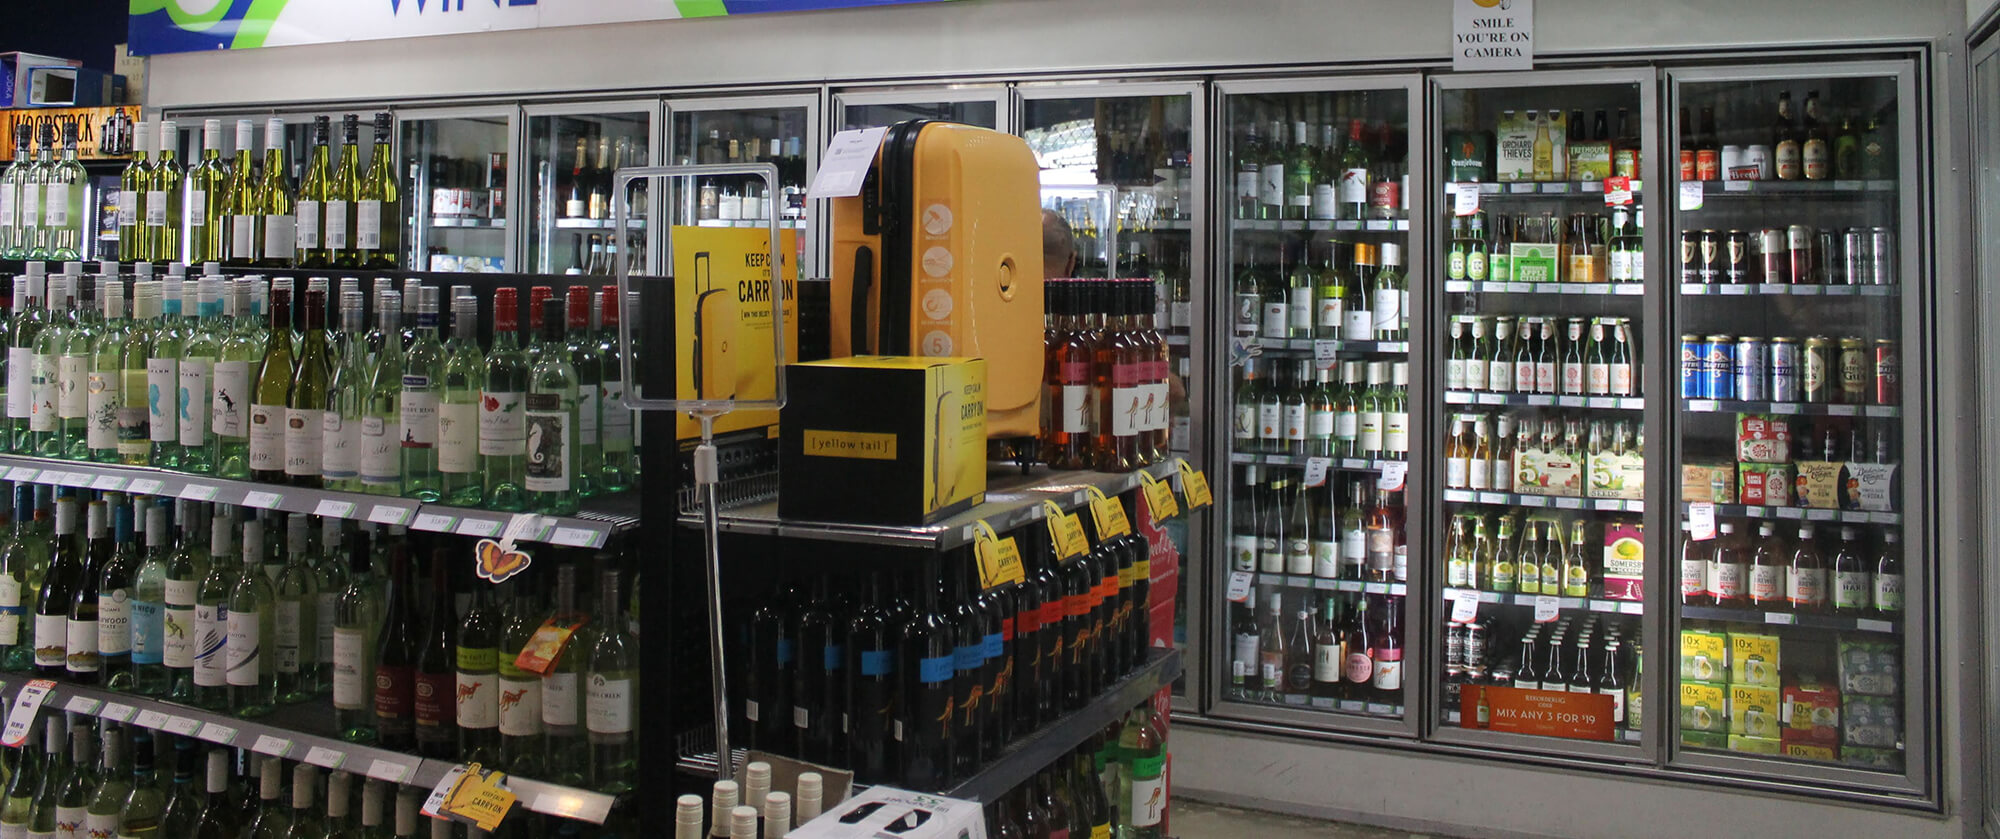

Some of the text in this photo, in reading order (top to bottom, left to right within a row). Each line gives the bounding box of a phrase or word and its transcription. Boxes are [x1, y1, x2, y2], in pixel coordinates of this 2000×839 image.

[1472, 18, 1514, 28] SMILE
[1457, 32, 1529, 43] YOU'RE ON
[1464, 47, 1522, 58] CAMERA
[1502, 140, 1532, 149] ORCHARD
[1503, 149, 1532, 159] THIEVES
[745, 253, 764, 267] KEEP
[933, 338, 942, 354] 5
[819, 438, 856, 450] yellow
[860, 439, 881, 450] tail
[1591, 490, 1619, 498] SEEDS
[1683, 635, 1700, 645] 10x
[1735, 639, 1753, 648] 10x
[1682, 686, 1699, 696] 10x
[1735, 689, 1753, 700] 10x
[1793, 703, 1811, 714] 10x
[1496, 708, 1596, 725] MIX ANY 3 FOR $19
[1790, 746, 1809, 756] 10x
[472, 797, 503, 814] CARRY ON
